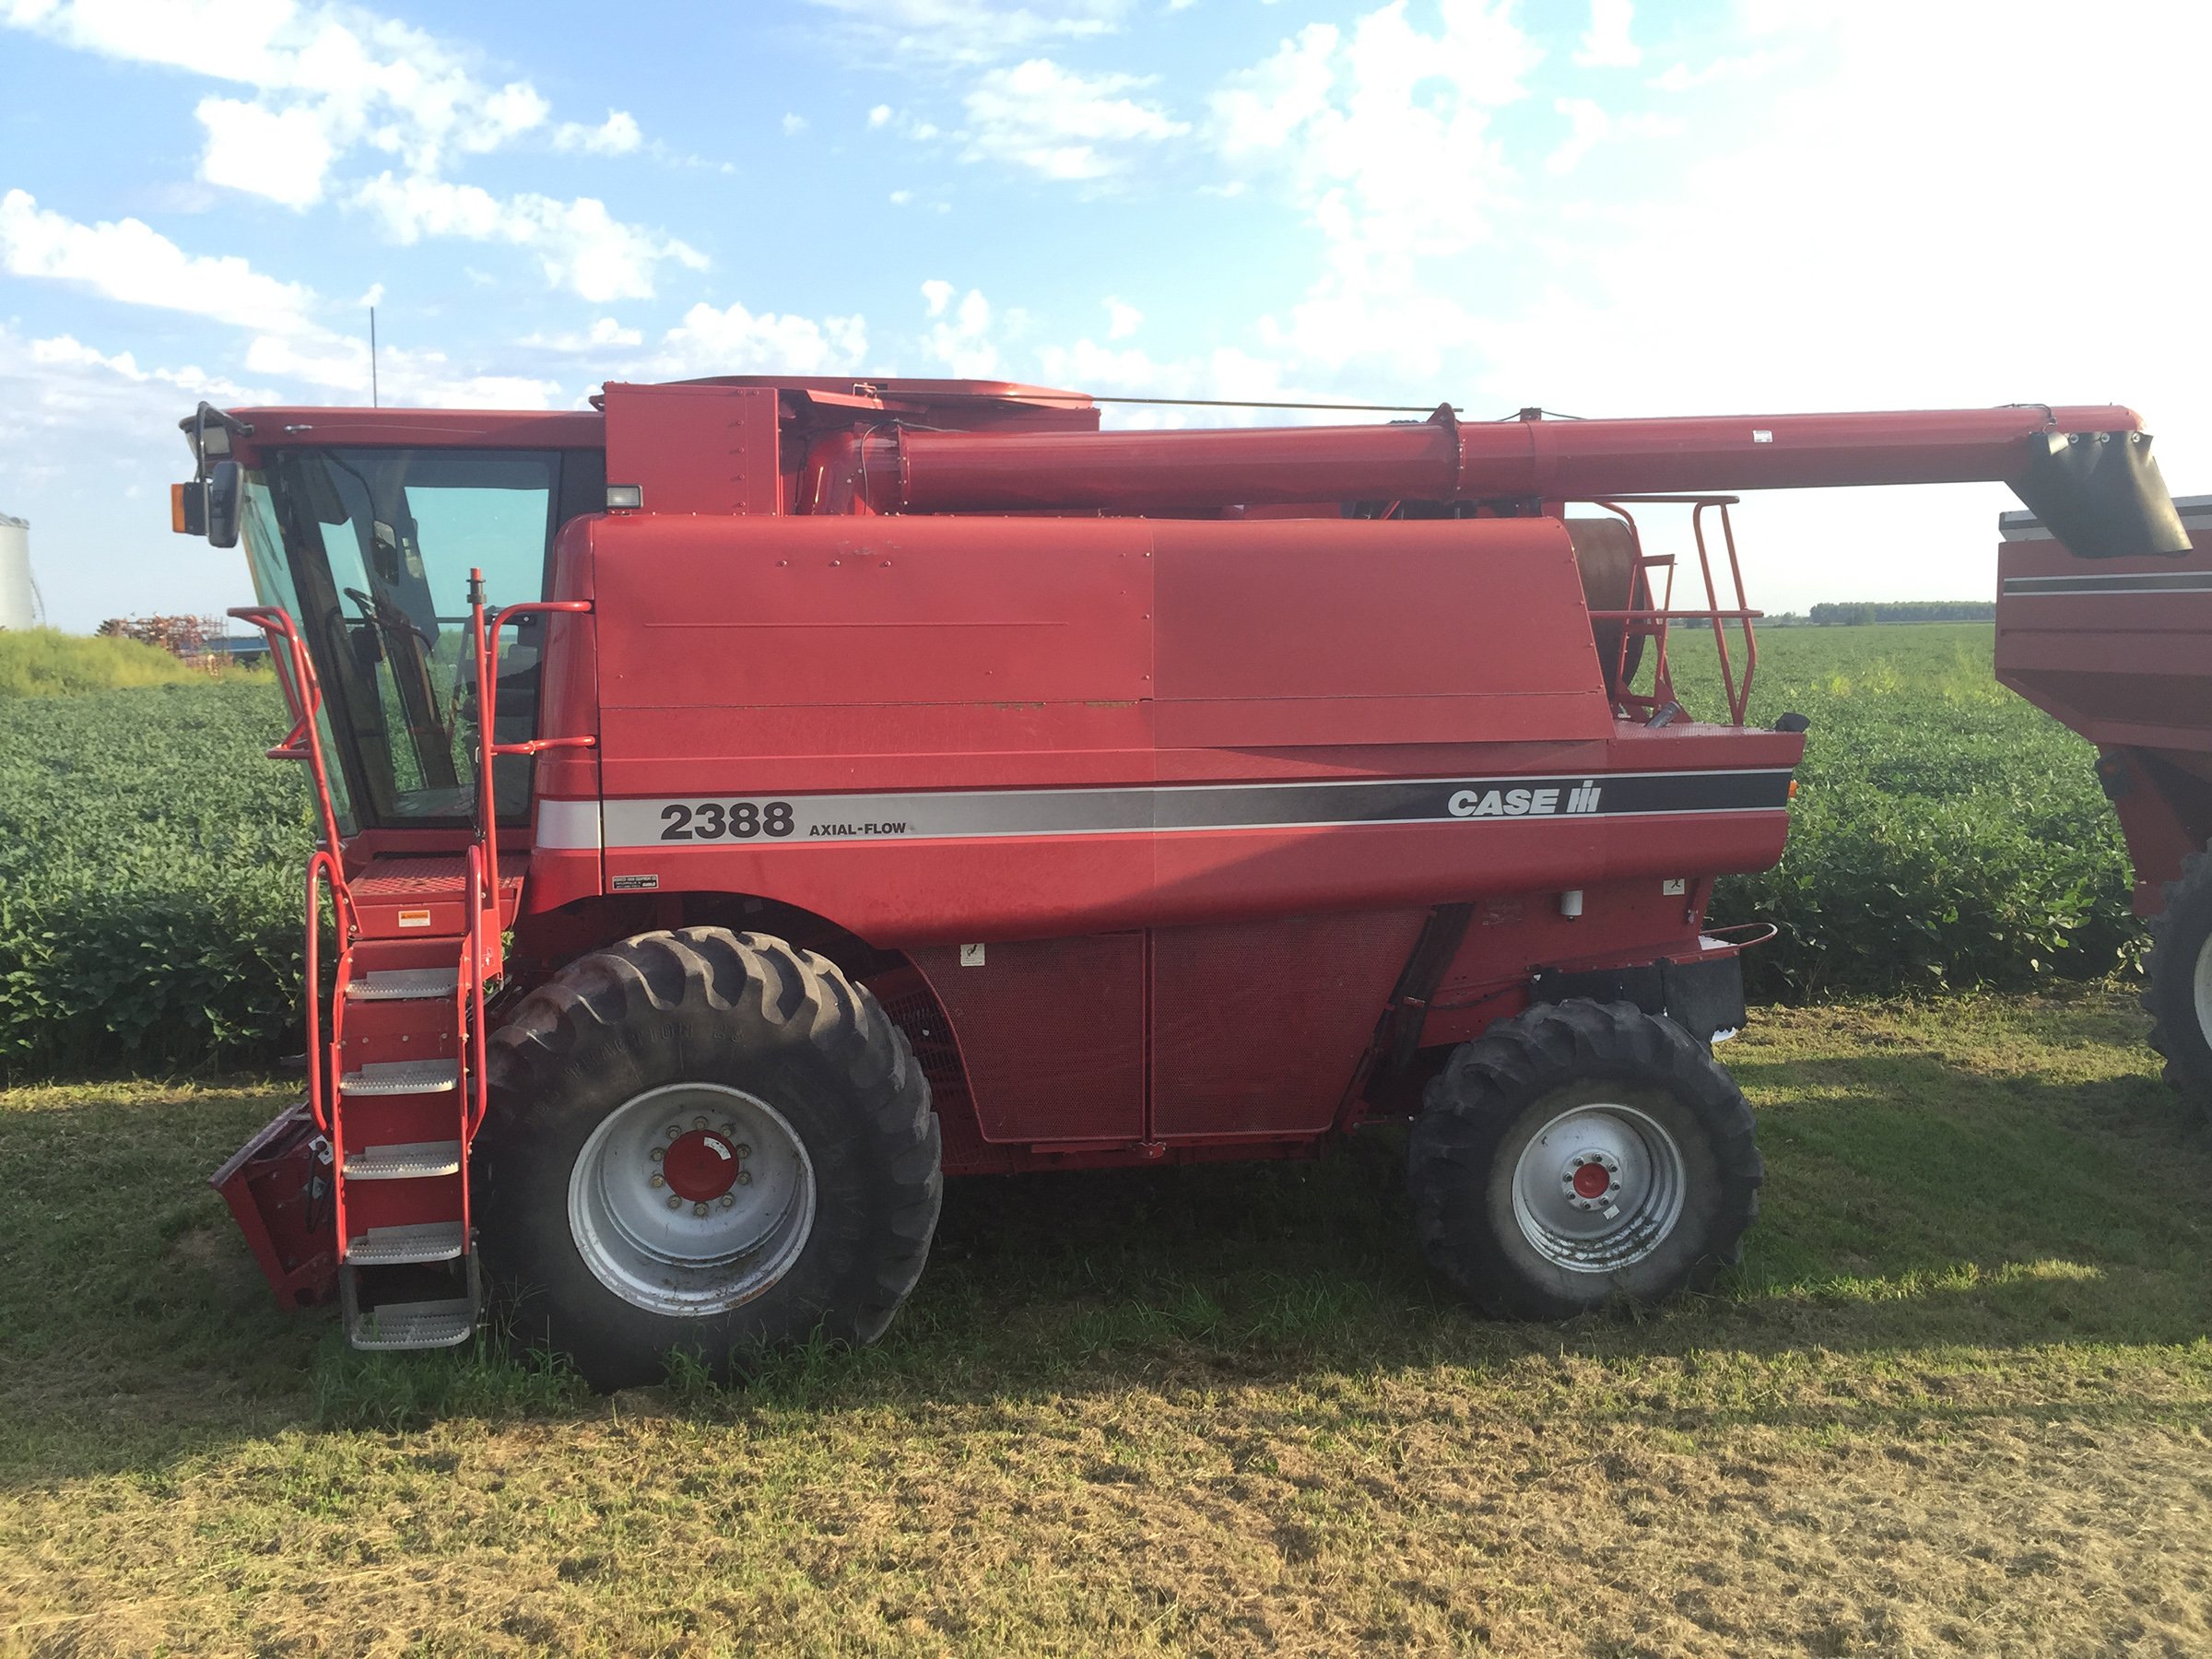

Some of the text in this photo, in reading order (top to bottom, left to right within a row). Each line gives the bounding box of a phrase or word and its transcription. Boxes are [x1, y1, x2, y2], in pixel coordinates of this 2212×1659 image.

[1447, 788, 1559, 817] CASE
[661, 802, 906, 840] 2388 AXIAL-FLOW
